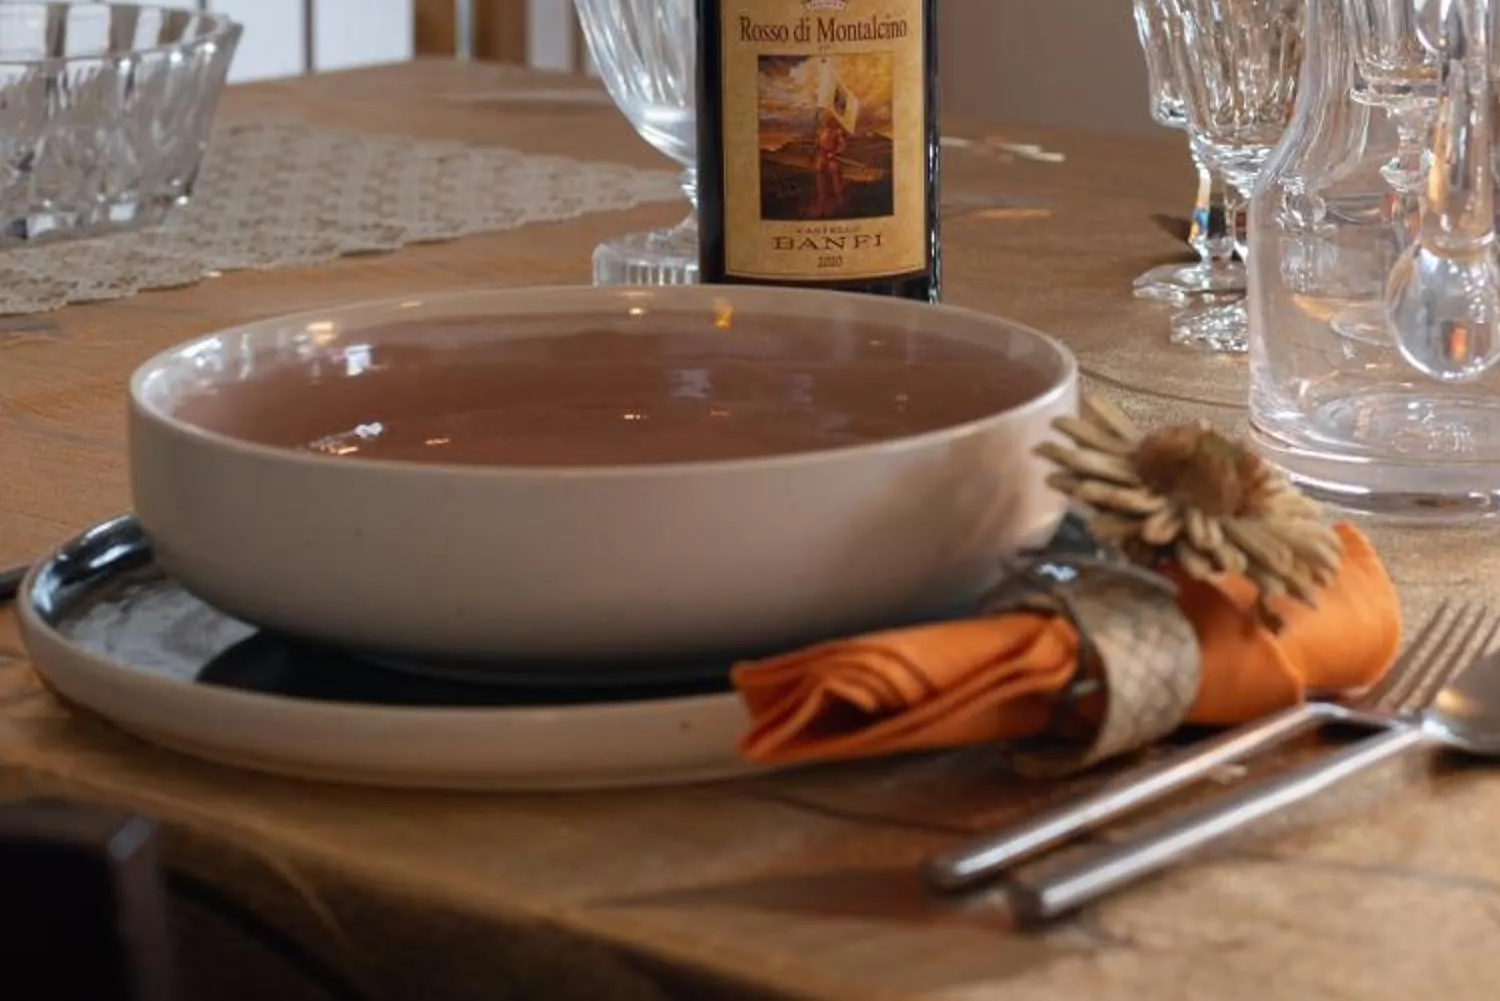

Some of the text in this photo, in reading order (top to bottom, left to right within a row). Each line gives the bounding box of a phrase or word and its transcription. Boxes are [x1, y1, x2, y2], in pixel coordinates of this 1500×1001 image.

[740, 14, 908, 42] Rosso di Montalcino
[773, 234, 883, 251] BANFI
